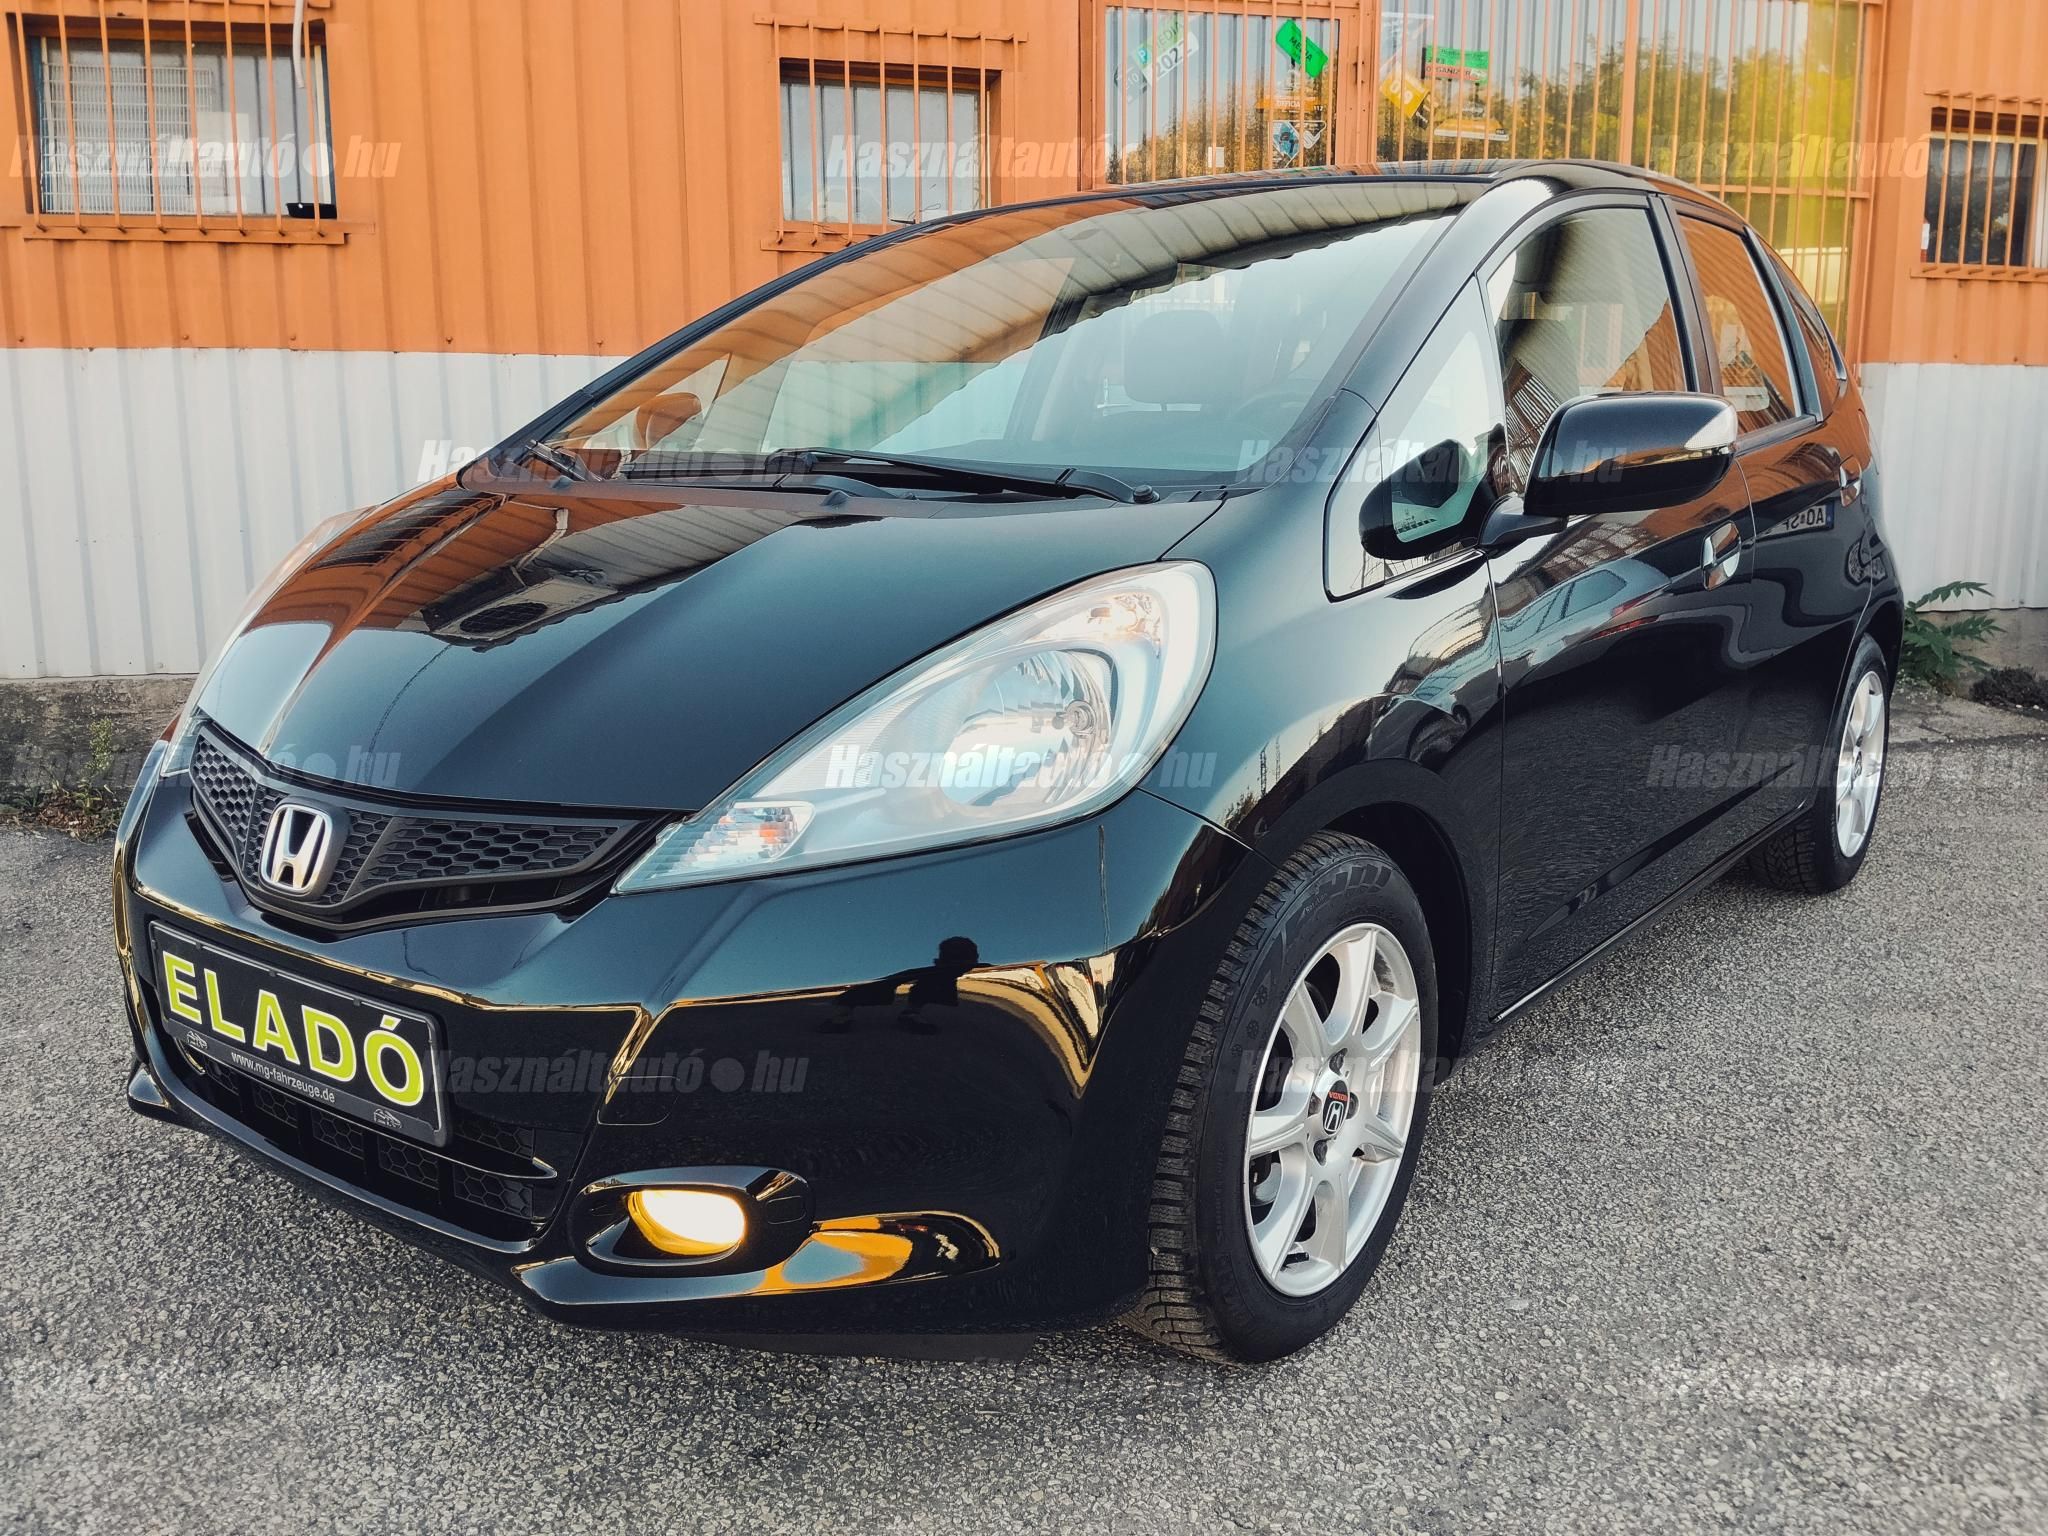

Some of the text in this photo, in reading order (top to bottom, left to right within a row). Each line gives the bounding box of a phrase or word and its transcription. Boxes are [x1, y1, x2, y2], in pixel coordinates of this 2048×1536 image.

[1289, 35, 1313, 63] MEIA
[1426, 66, 1471, 77] OGANIZR
[162, 950, 425, 1107] ELADÓ
[230, 1051, 336, 1103] www.mg-fahrzeuge.de
